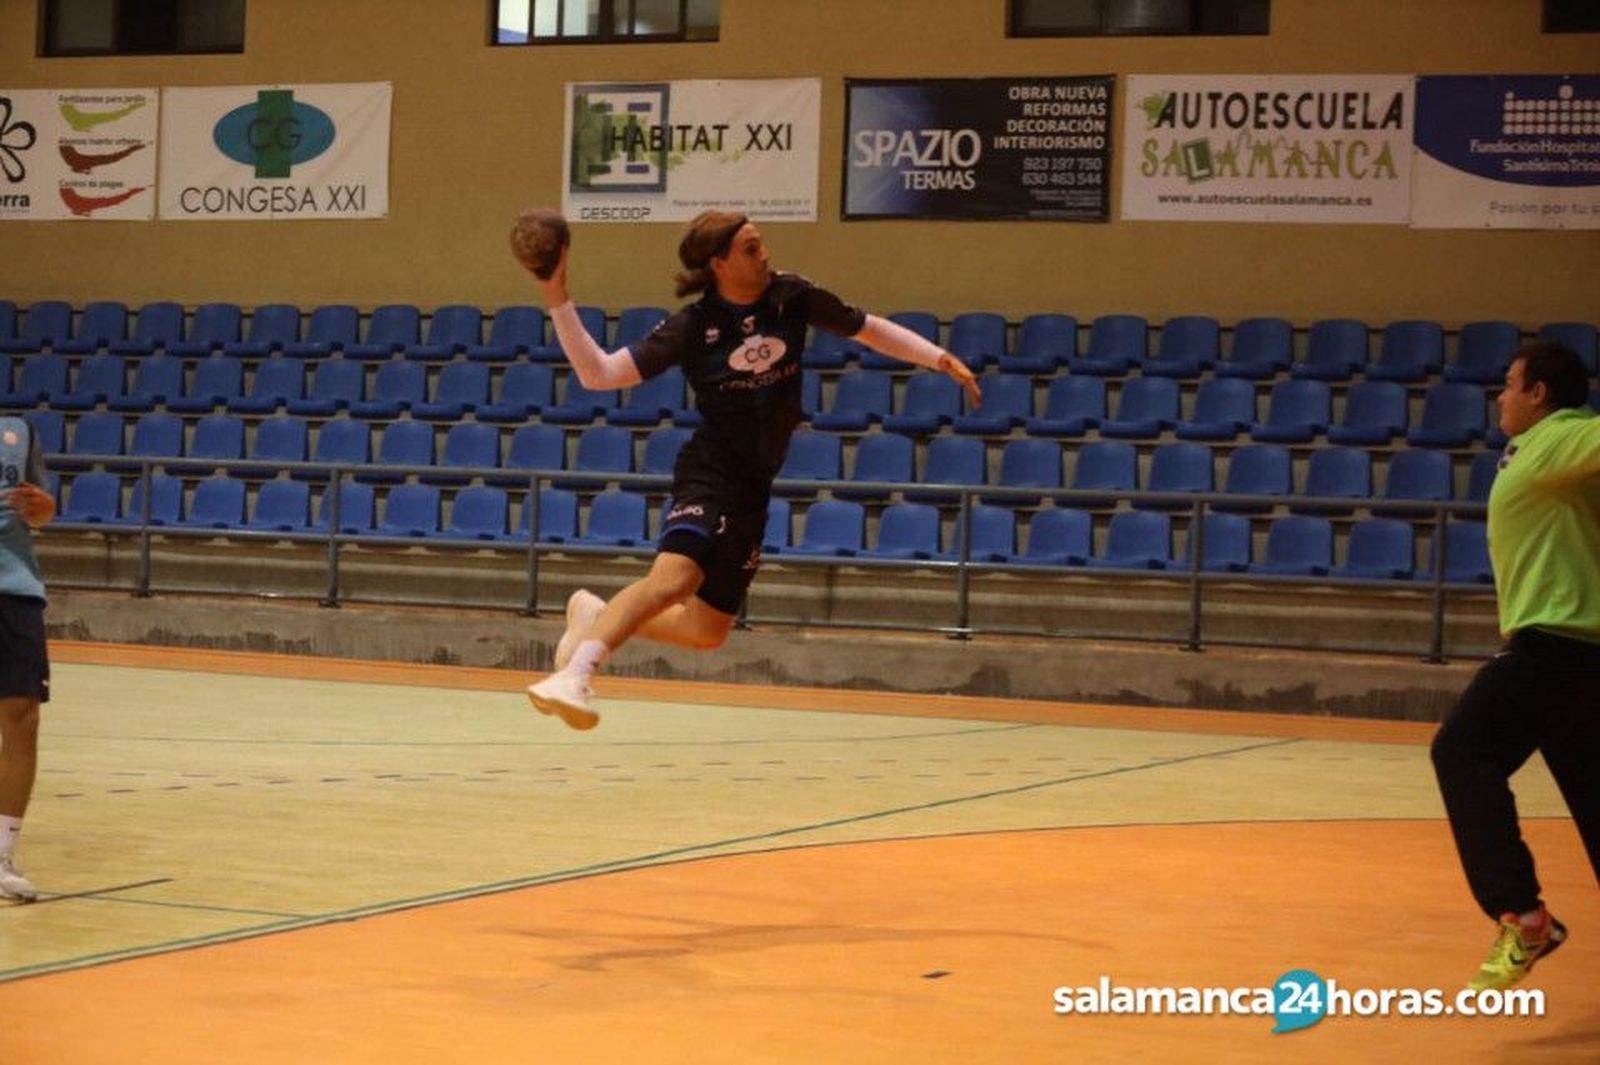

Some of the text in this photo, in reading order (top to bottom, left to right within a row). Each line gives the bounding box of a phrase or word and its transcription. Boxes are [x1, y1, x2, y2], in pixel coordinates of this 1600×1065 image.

[1009, 86, 1107, 100] OBRA NUEVA
[1023, 102, 1107, 116] REFORMAS
[1155, 91, 1404, 130] AUTOESCUELA
[247, 117, 303, 150] CG
[1006, 117, 1106, 133] DECORACIÓN
[610, 123, 793, 152] HABITAT XXI
[993, 135, 1105, 150] INTERIORISMO
[853, 128, 982, 168] SPAZIO
[1140, 137, 1399, 184] SALAMANCA
[902, 170, 976, 190] TERMAS
[180, 185, 367, 214] CONGESA XXI
[1158, 193, 1372, 207] www.autoescuelasalamanca.es
[744, 344, 771, 363] CG
